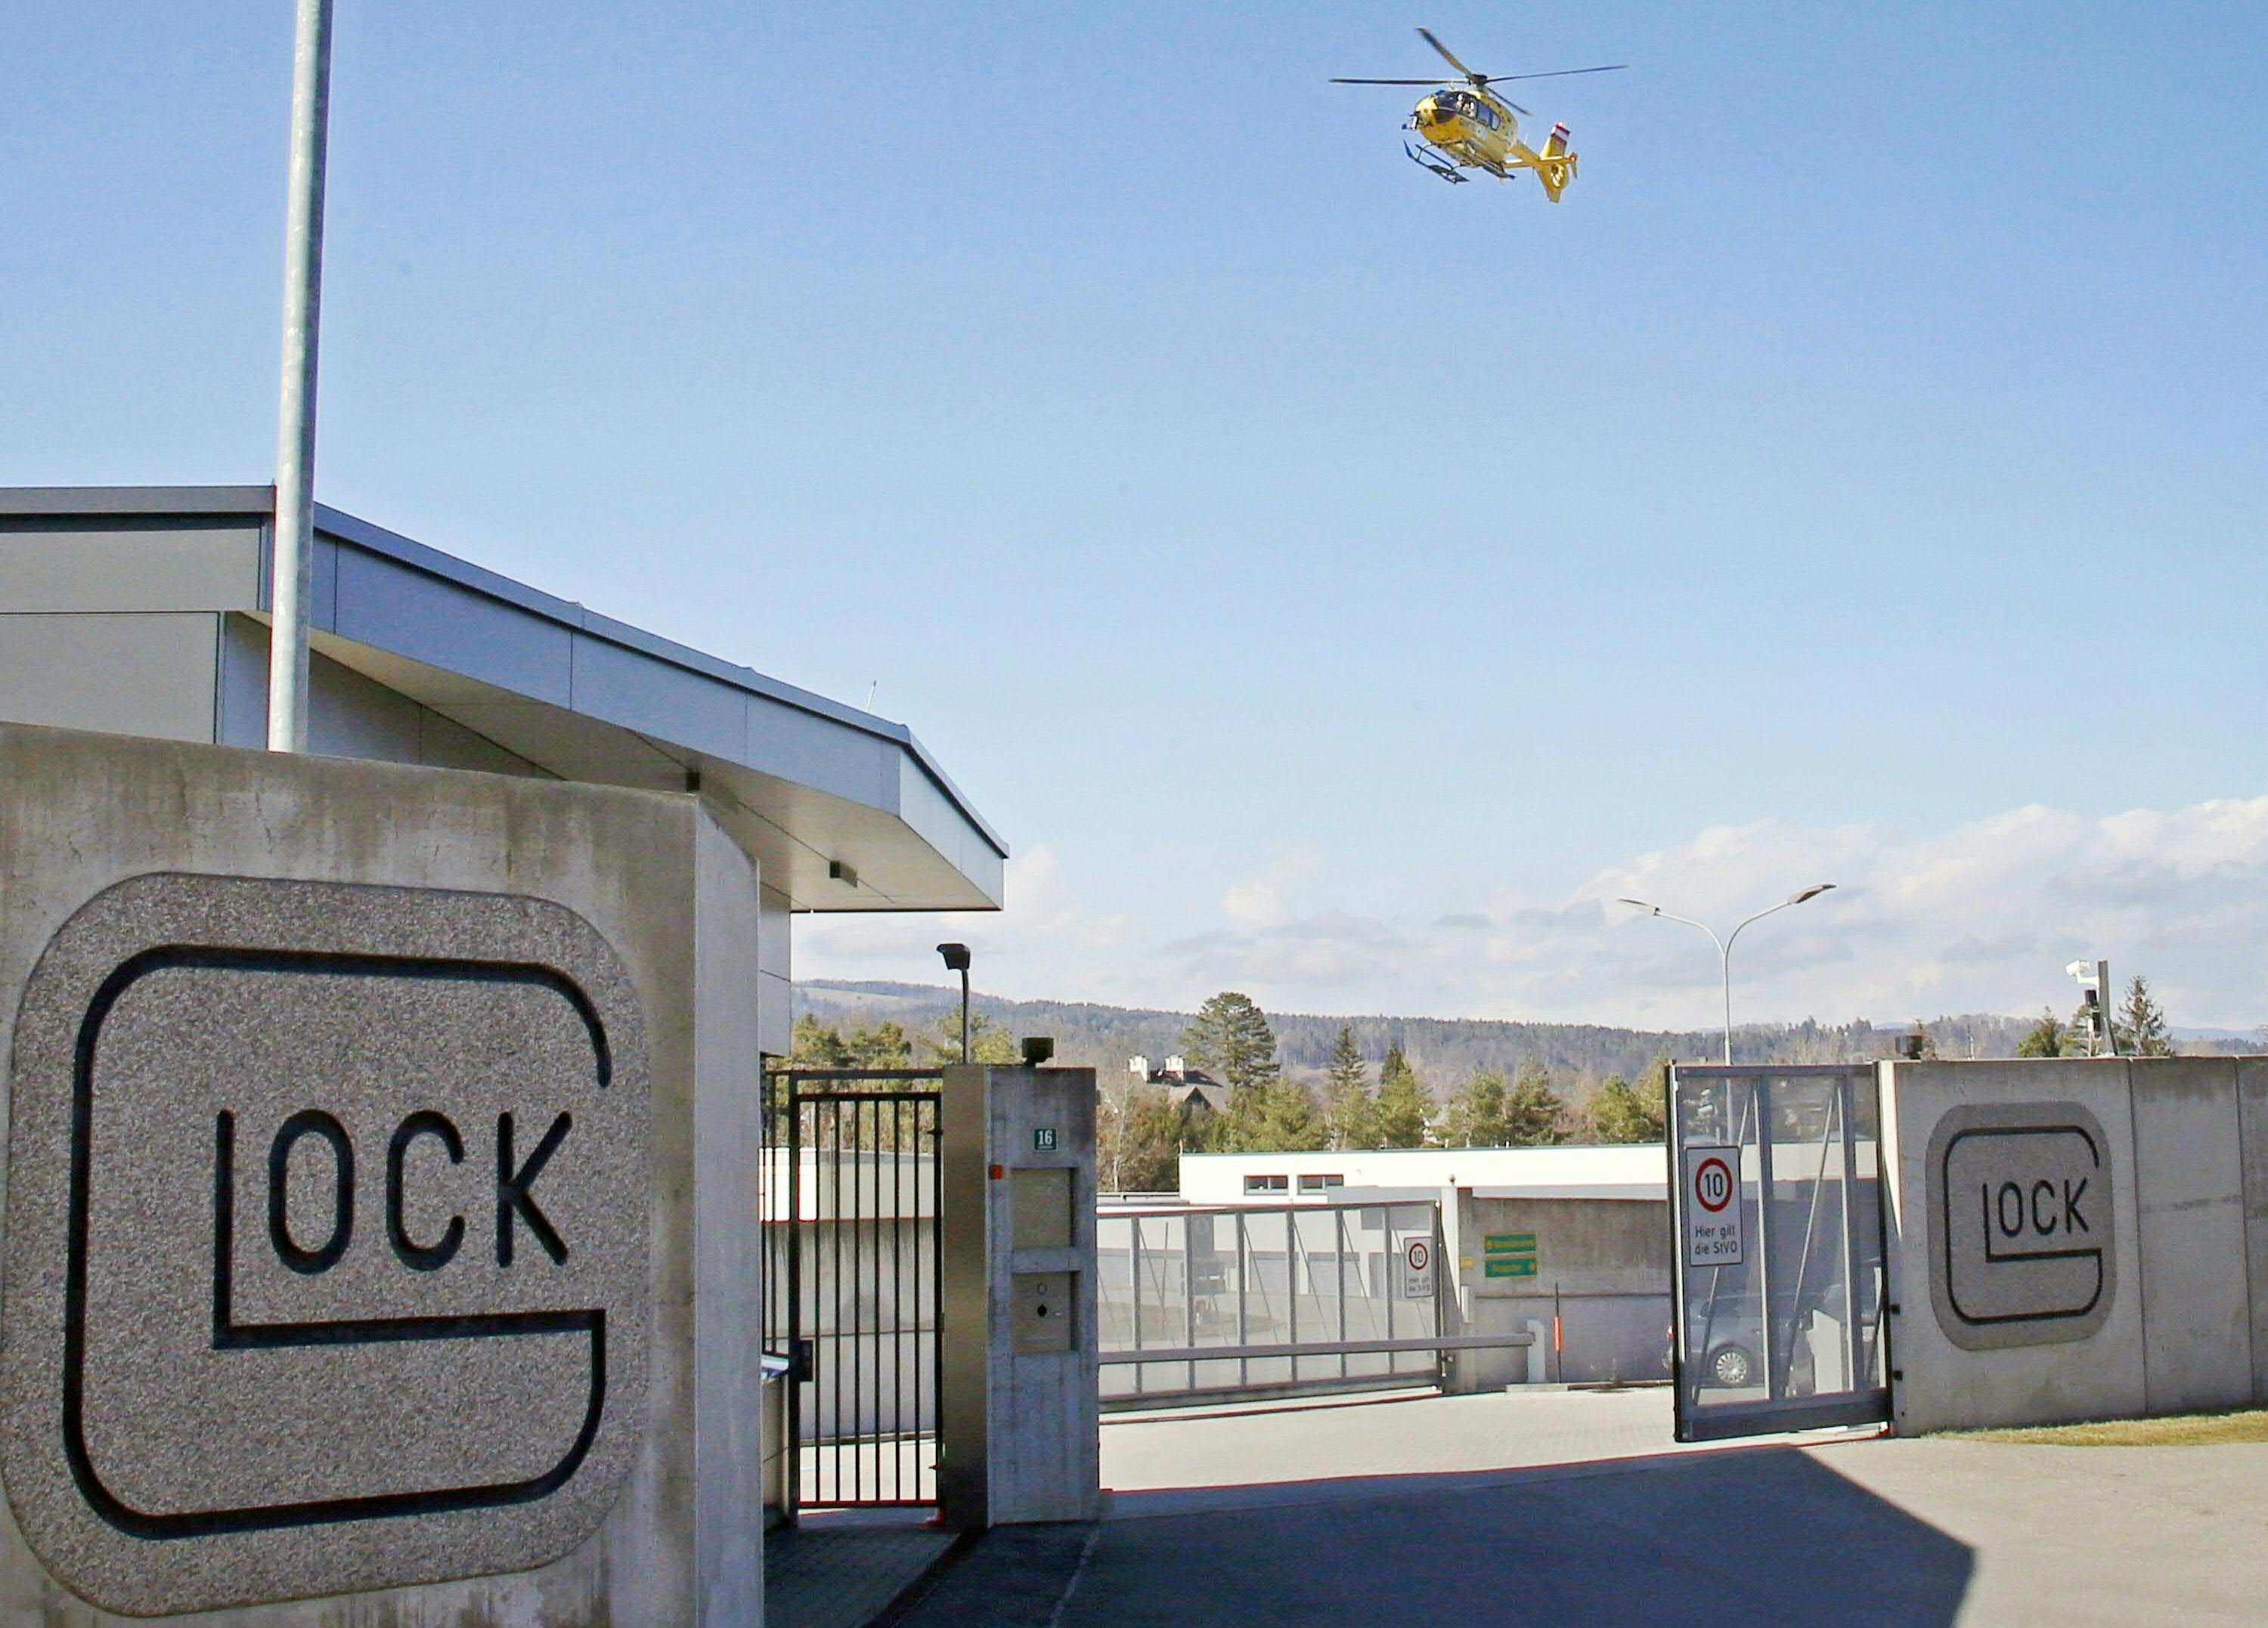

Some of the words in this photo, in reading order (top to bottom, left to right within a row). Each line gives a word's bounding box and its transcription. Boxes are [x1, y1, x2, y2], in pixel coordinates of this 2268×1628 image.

[1038, 1129, 1053, 1145] 16
[1705, 1173, 1724, 1198] 10
[1695, 1224, 1715, 1238] Hier
[1720, 1224, 1736, 1240] gilt
[1694, 1242, 1710, 1255] die
[1713, 1240, 1737, 1255] StVO
[1414, 1249, 1424, 1263] 10
